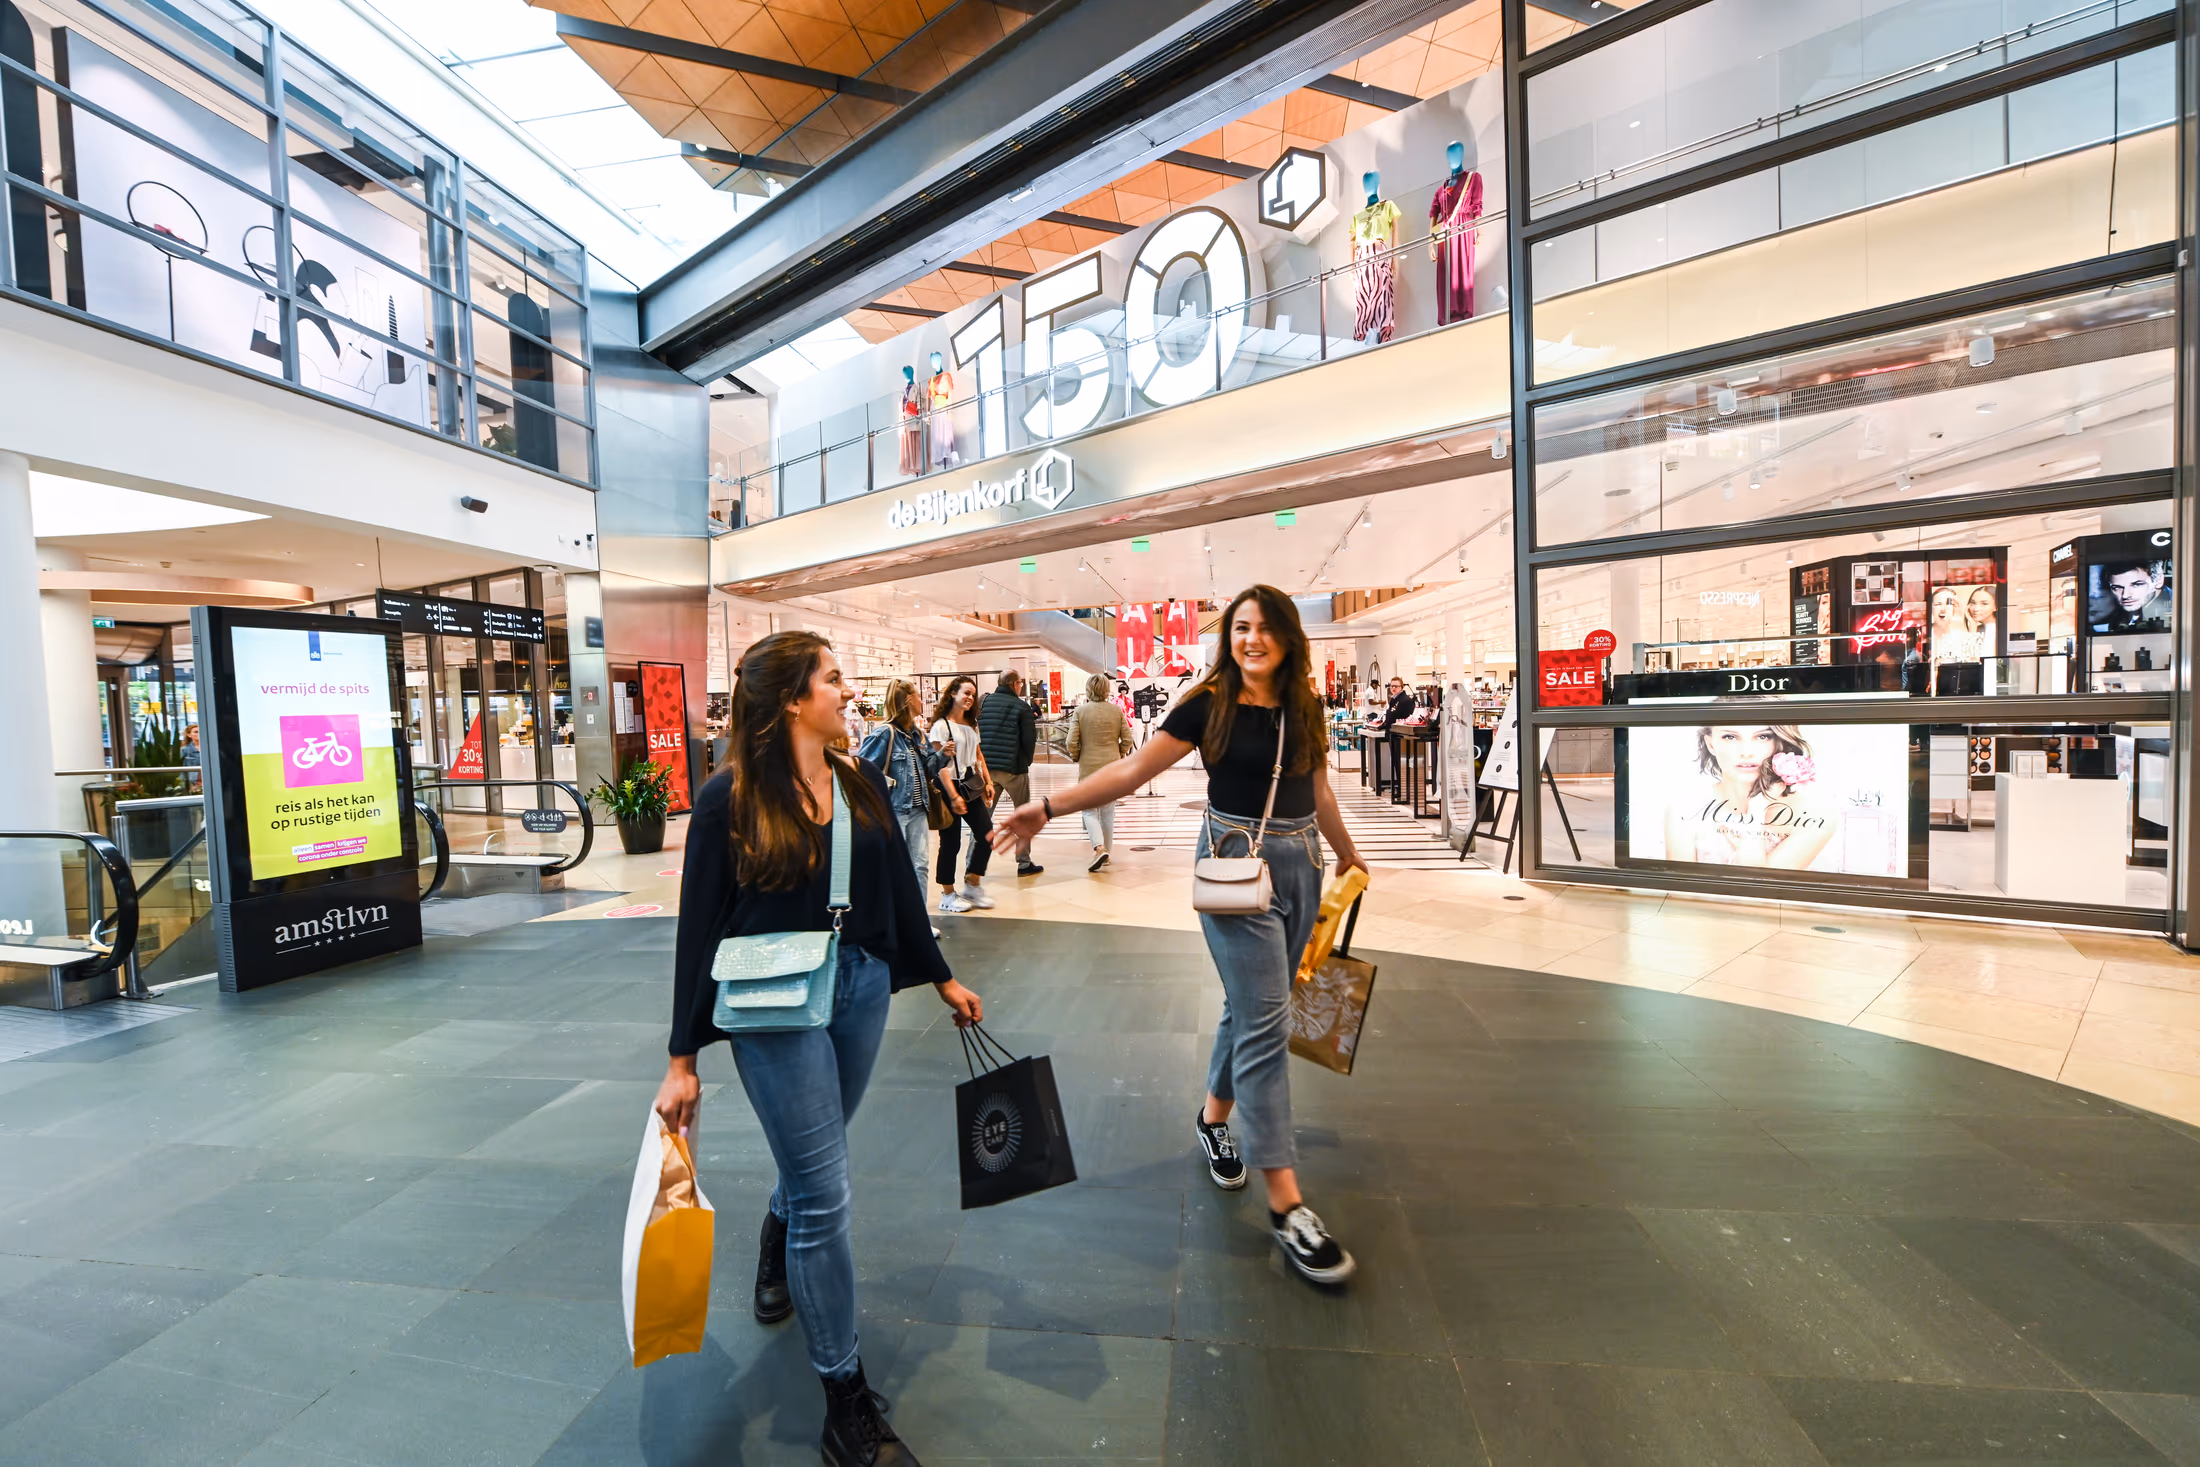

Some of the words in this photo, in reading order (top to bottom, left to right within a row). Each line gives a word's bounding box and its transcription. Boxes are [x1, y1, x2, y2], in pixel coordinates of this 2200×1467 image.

[951, 205, 1250, 459] 150
[2053, 544, 2074, 563] CHANEL
[1546, 671, 1595, 686] SALE
[1728, 674, 1789, 692] Dior
[260, 682, 316, 697] vermijd
[319, 682, 336, 694] de
[339, 682, 370, 697] spits
[470, 741, 482, 749] TOT
[650, 733, 682, 749] SALE
[462, 749, 484, 764] 30%
[458, 766, 484, 774] KORTING
[276, 800, 302, 813] reis
[304, 798, 324, 810] als
[327, 796, 349, 808] het
[351, 794, 375, 805] kan
[270, 819, 290, 832] op
[293, 812, 341, 826] rustige
[344, 807, 381, 822] tijden
[1681, 798, 1754, 825] Miss
[1761, 801, 1825, 829] Dior
[293, 846, 313, 854] alleen
[337, 838, 357, 847] krijgen
[298, 853, 320, 862] corona
[320, 850, 339, 858] onder
[339, 846, 363, 855] controle
[274, 903, 390, 945] amstlvn
[985, 1121, 1006, 1137] EYE
